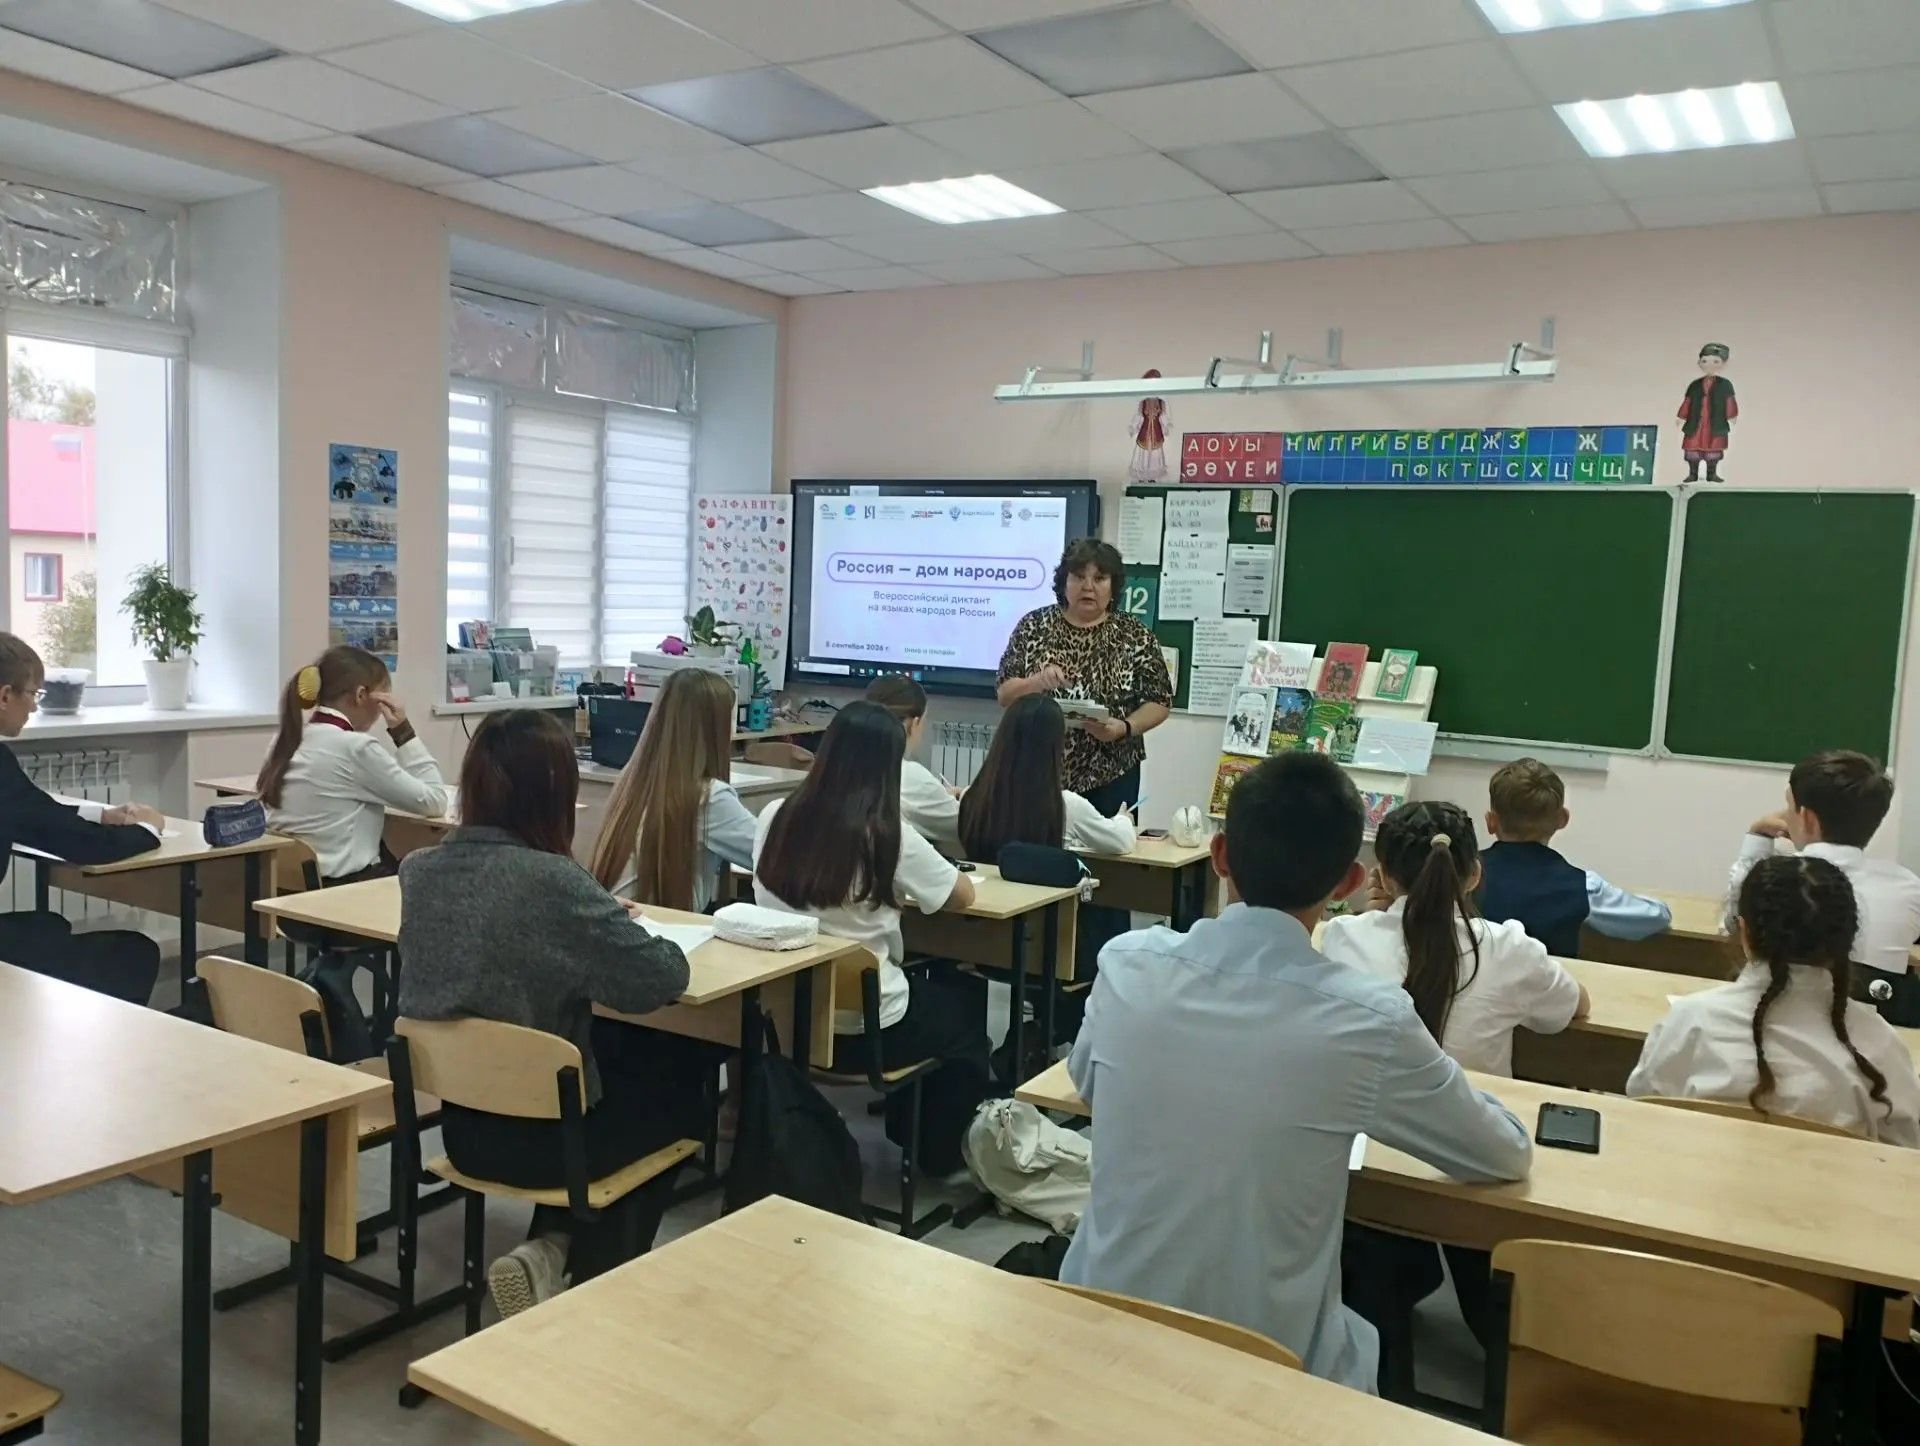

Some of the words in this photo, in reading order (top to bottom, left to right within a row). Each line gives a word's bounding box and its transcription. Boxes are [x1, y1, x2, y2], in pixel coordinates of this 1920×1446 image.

[1188, 438, 1199, 452] А
[1207, 438, 1220, 452] О
[1228, 438, 1238, 452] У
[1245, 438, 1260, 452] Ы
[1307, 437, 1320, 451] М
[1329, 437, 1340, 451] Л
[1351, 437, 1362, 451] Р
[1395, 436, 1406, 450] Б
[1417, 436, 1428, 450] В
[1441, 436, 1450, 450] Г
[1460, 435, 1475, 452] Д
[1482, 435, 1500, 449] Ж
[1509, 435, 1521, 449] З
[1245, 461, 1255, 477] Е
[1265, 461, 1277, 476] И
[1391, 463, 1404, 477] П
[1413, 463, 1428, 477] Ф
[1437, 463, 1448, 477] К
[1461, 463, 1472, 477] Т
[1480, 462, 1498, 477] Ш
[1506, 462, 1519, 477] С
[1530, 462, 1543, 477] Х
[1554, 462, 1568, 480] Ц
[1581, 462, 1593, 477] Ч
[711, 500, 776, 511] АЛФАВИТ
[837, 559, 894, 575] Россия
[916, 565, 949, 578] дом
[953, 566, 1027, 581] народов
[873, 591, 949, 603] Всероссийский
[951, 595, 991, 605] диктант
[1125, 586, 1149, 614] 12
[868, 604, 879, 612] на
[881, 604, 914, 613] языках
[916, 606, 957, 616] народов
[960, 607, 996, 617] России
